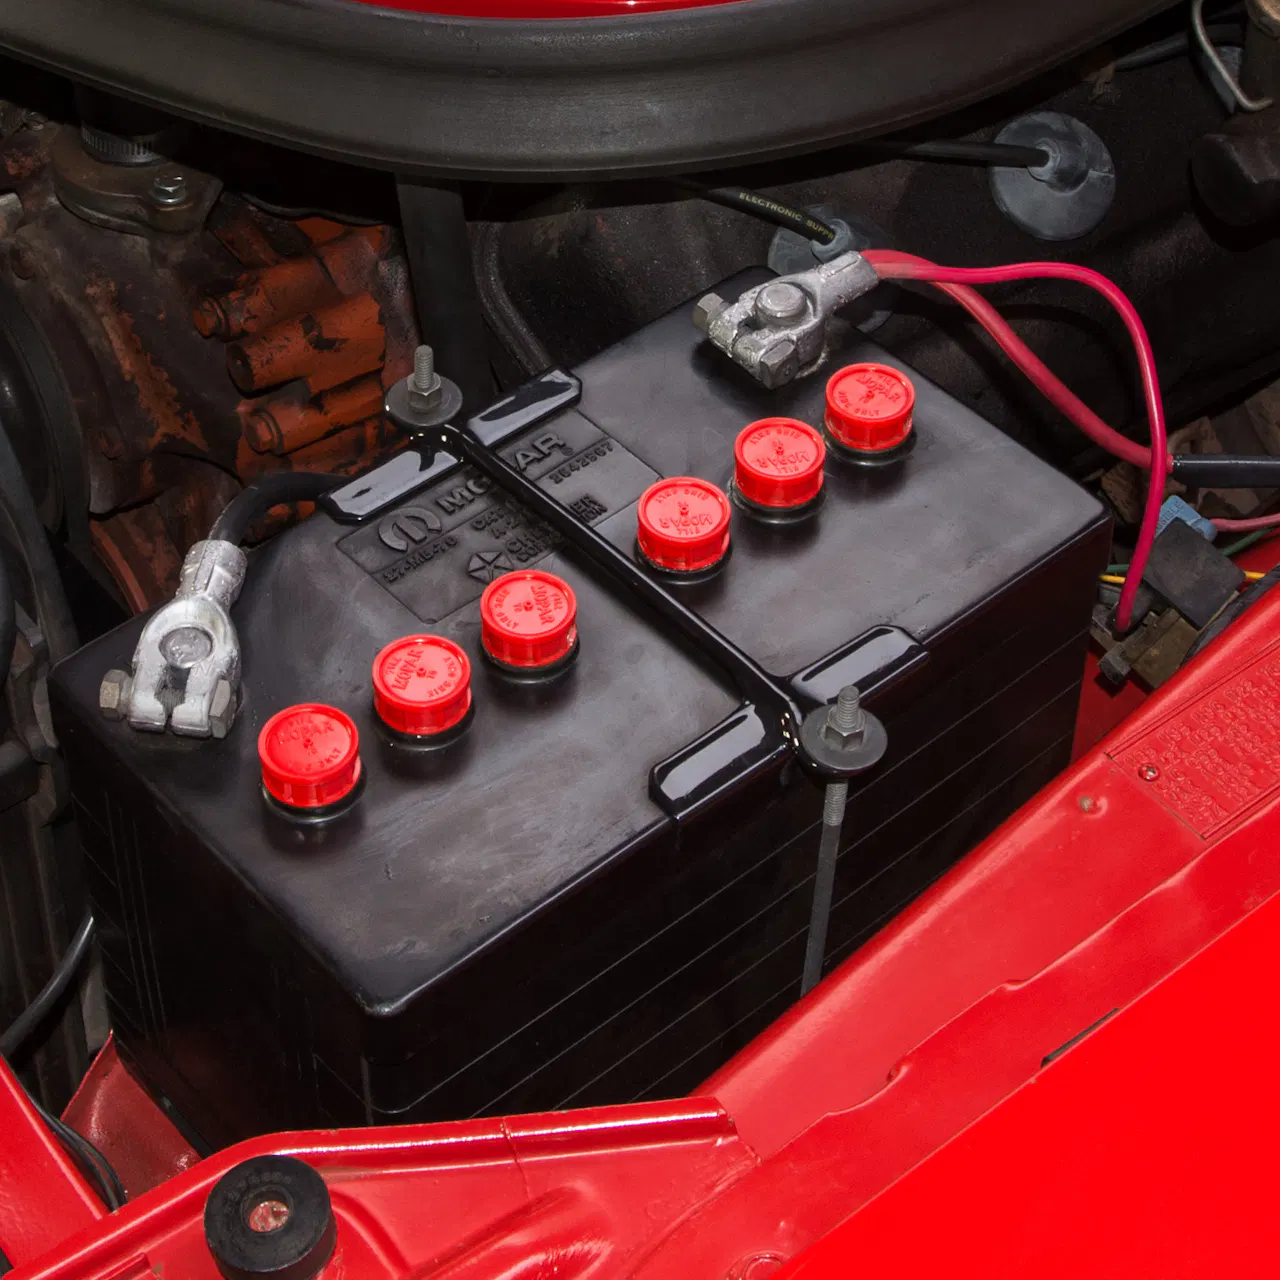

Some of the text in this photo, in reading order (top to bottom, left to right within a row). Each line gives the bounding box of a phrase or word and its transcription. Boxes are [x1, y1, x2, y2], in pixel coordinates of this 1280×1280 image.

[739, 191, 803, 222] ELECTRONIC
[435, 430, 568, 517] MOAR
[756, 450, 810, 469] MOPAR
[658, 512, 714, 529] MOPAR
[530, 584, 556, 626] MOPAR
[391, 648, 425, 691] MOPAR
